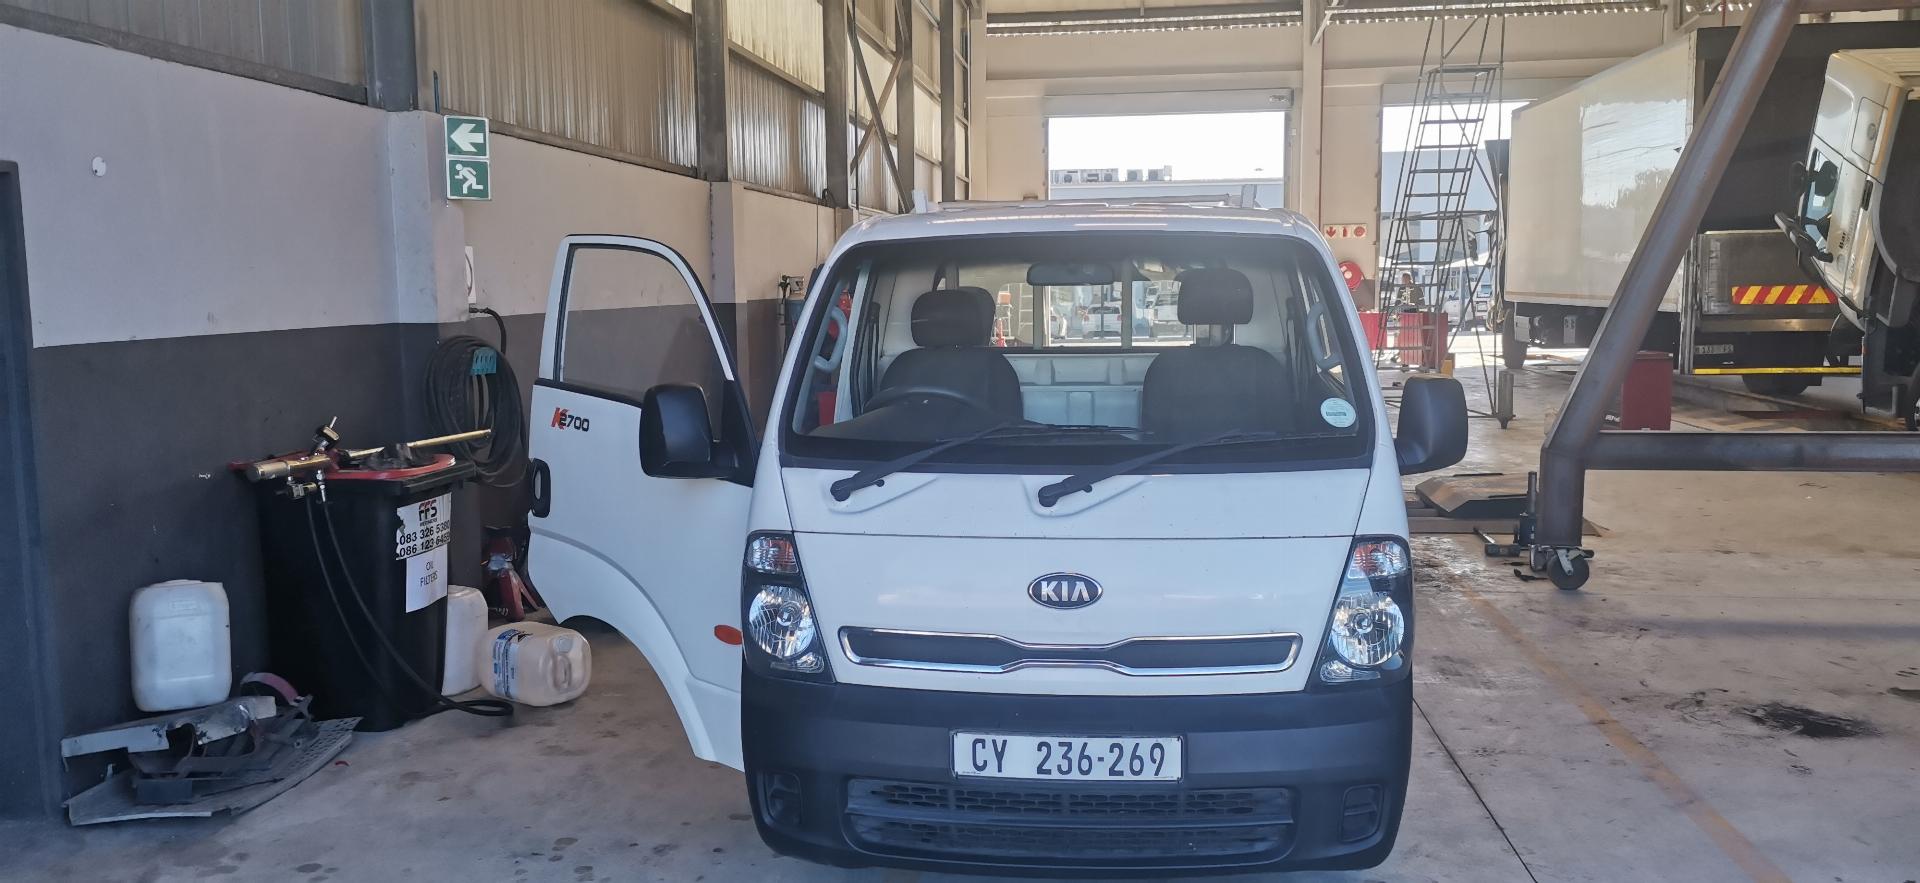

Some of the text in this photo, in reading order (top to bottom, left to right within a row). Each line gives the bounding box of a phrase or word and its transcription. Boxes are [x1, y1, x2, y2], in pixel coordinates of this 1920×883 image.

[551, 407, 590, 432] K2700
[419, 500, 438, 521] FFS
[399, 531, 418, 545] 083
[420, 526, 434, 540] 326
[399, 544, 418, 557] 086
[420, 538, 435, 551] 123
[426, 561, 434, 571] OIL
[420, 570, 438, 587] FILTERS
[1041, 580, 1091, 602] KIA
[971, 738, 1165, 777] CY 236-269
